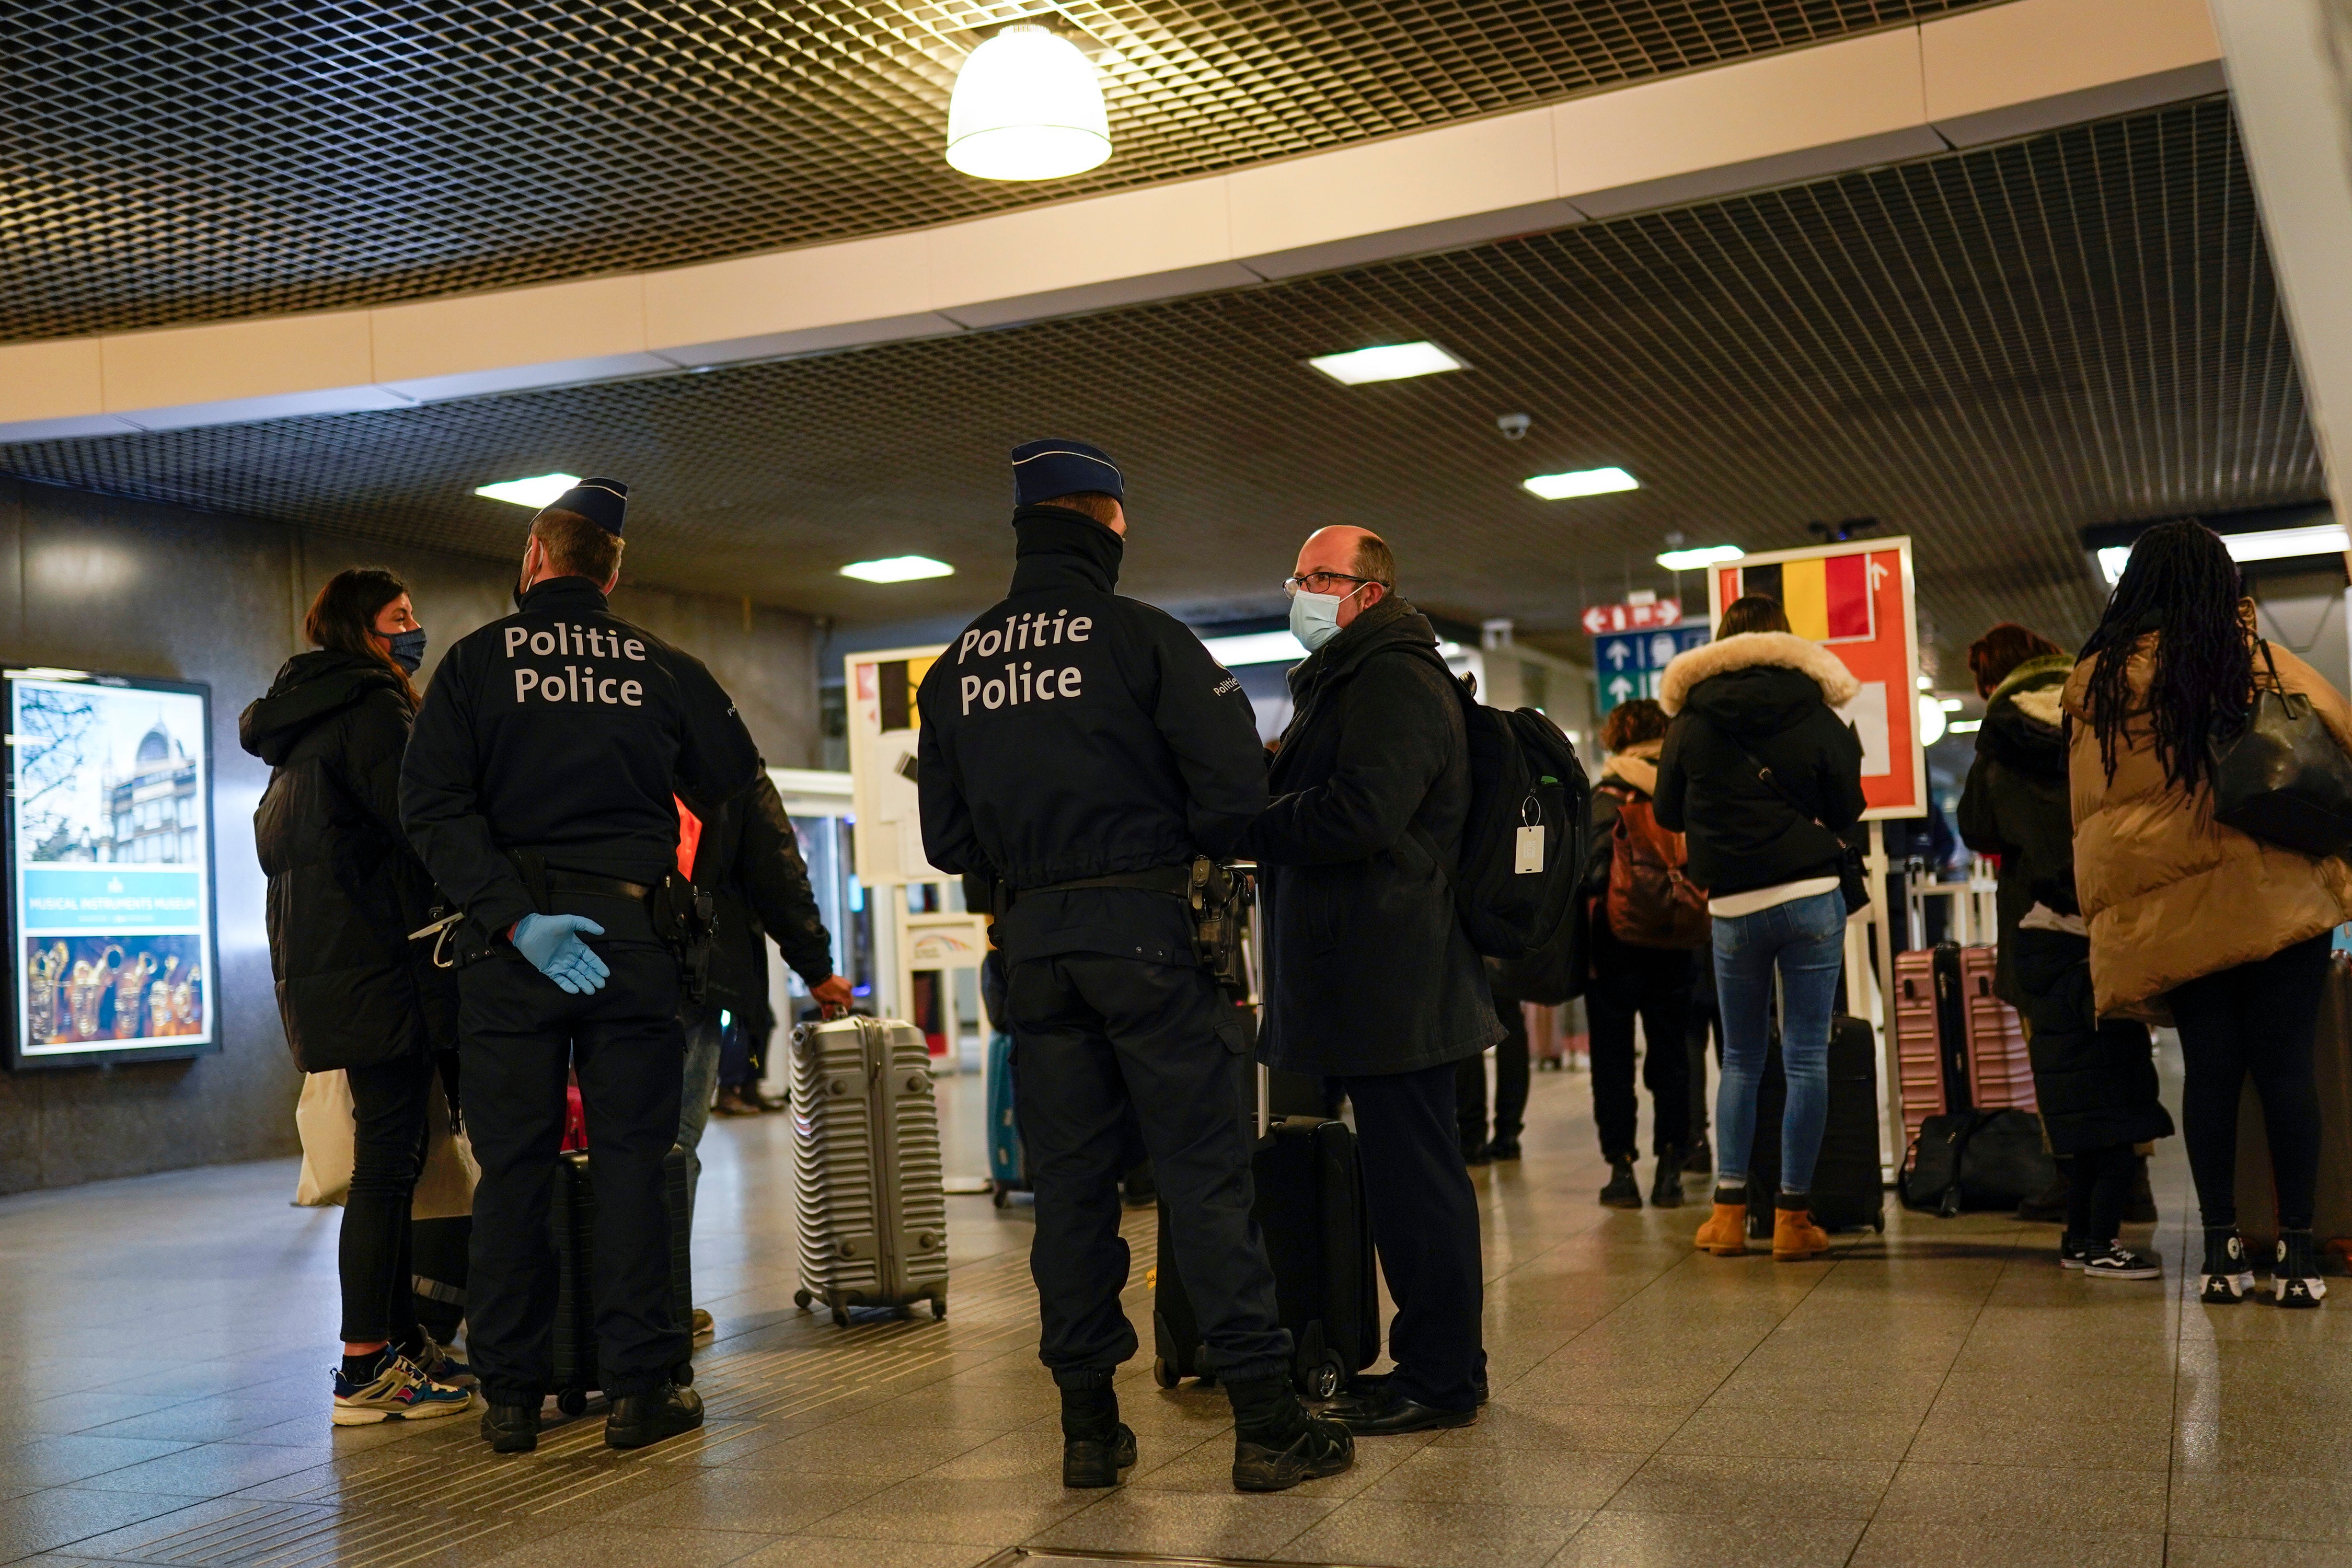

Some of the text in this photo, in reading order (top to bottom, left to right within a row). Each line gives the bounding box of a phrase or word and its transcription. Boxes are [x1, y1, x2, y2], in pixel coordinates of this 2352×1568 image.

[504, 622, 646, 661] Politie
[958, 609, 1092, 665] Politie
[515, 665, 643, 706] Police
[961, 661, 1082, 716] Police
[1213, 677, 1238, 697] Politie
[29, 897, 197, 911] MUSICAL INSTRUMENTS MUSEUM
